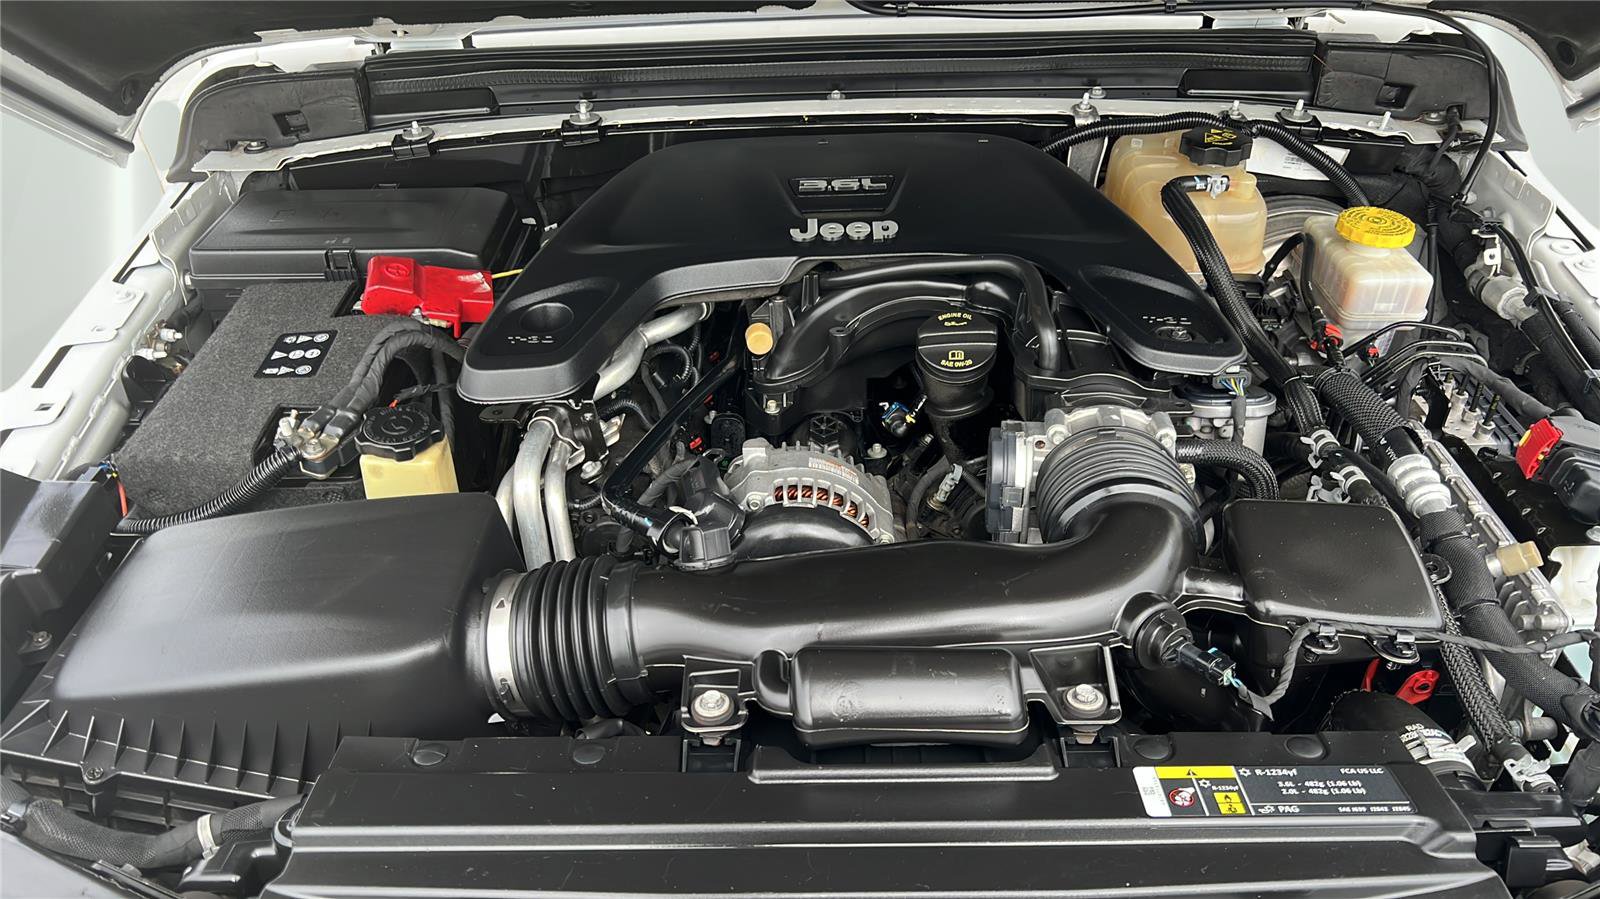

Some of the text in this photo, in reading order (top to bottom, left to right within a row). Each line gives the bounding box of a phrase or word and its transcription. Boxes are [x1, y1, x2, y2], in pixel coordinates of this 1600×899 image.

[798, 178, 888, 193] 3.6L
[789, 218, 899, 243] Jeep
[937, 312, 973, 321] ENGINE OIL
[940, 359, 973, 368] SAE 0W-20
[1254, 768, 1298, 777] R-1234yf
